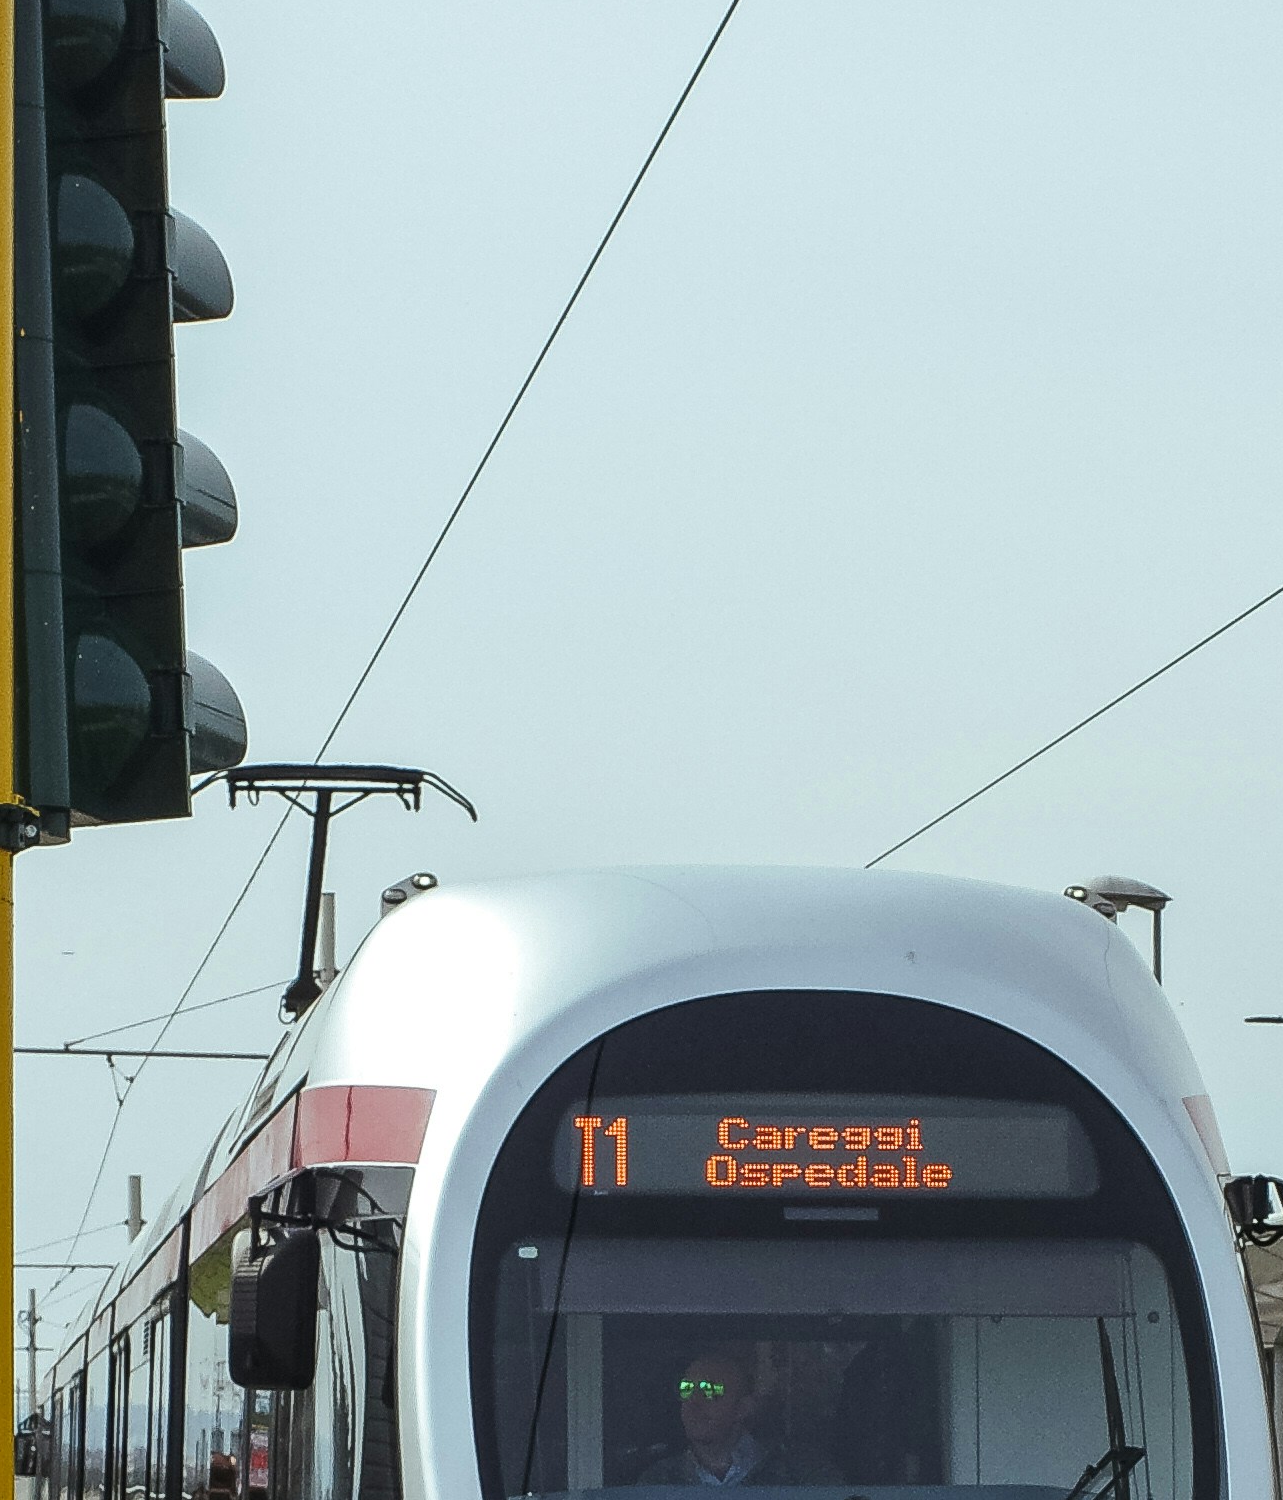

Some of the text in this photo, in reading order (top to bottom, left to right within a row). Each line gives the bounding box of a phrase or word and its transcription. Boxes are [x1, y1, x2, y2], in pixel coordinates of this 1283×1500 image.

[717, 1116, 924, 1151] Careggi
[573, 1116, 628, 1187] T1
[704, 1154, 954, 1188] Ospedale
